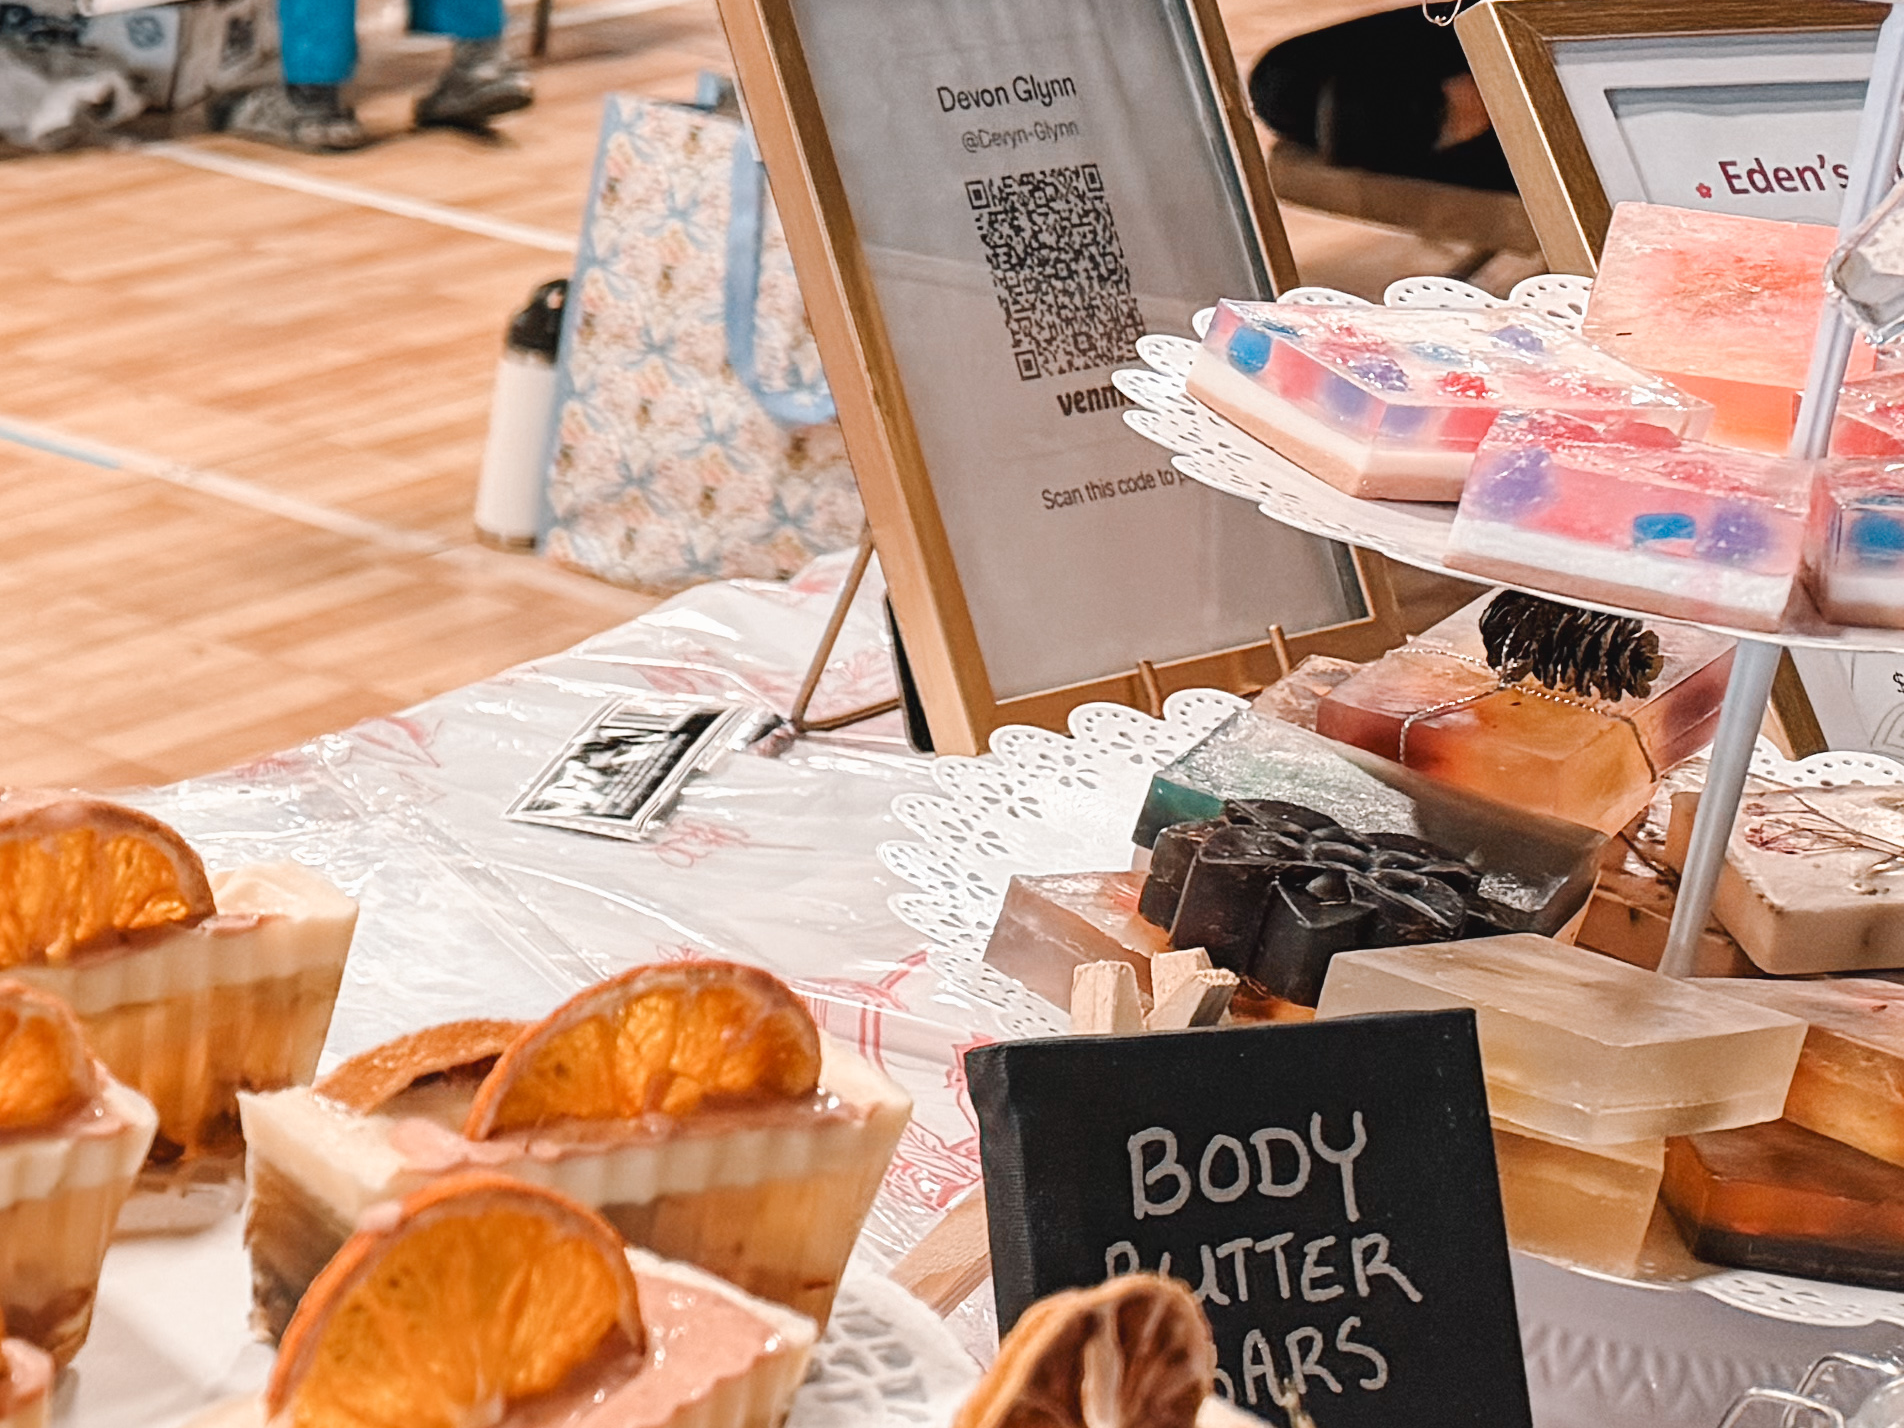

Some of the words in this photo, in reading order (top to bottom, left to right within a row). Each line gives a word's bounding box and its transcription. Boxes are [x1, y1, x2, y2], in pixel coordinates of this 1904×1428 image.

[936, 85, 1011, 113] Devon
[1012, 74, 1078, 108] Glynn
[1718, 154, 1849, 196] Eden's
[1056, 384, 1136, 417] venm
[1041, 488, 1085, 510] Scan
[1085, 478, 1116, 500] this
[1117, 470, 1157, 495] code
[1157, 468, 1175, 487] to
[1127, 1110, 1369, 1224] BODY
